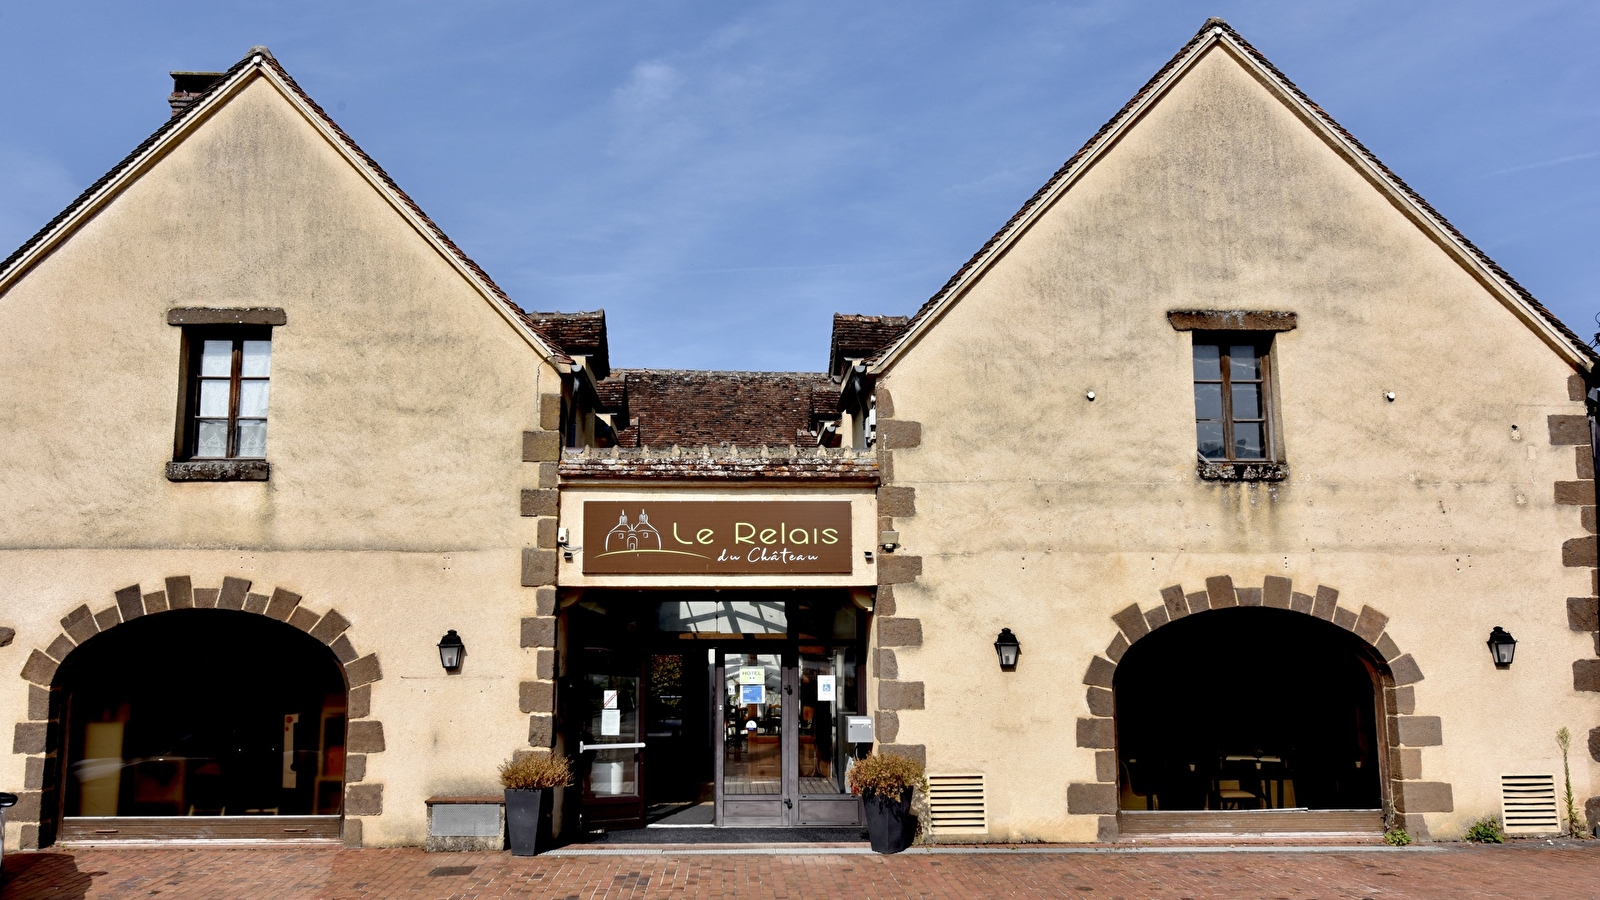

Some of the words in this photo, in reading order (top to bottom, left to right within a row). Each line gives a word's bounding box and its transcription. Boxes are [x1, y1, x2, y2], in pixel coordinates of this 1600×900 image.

[673, 522, 714, 545] Le
[735, 522, 839, 545] Relais
[717, 548, 740, 562] du
[747, 546, 818, 564] Château
